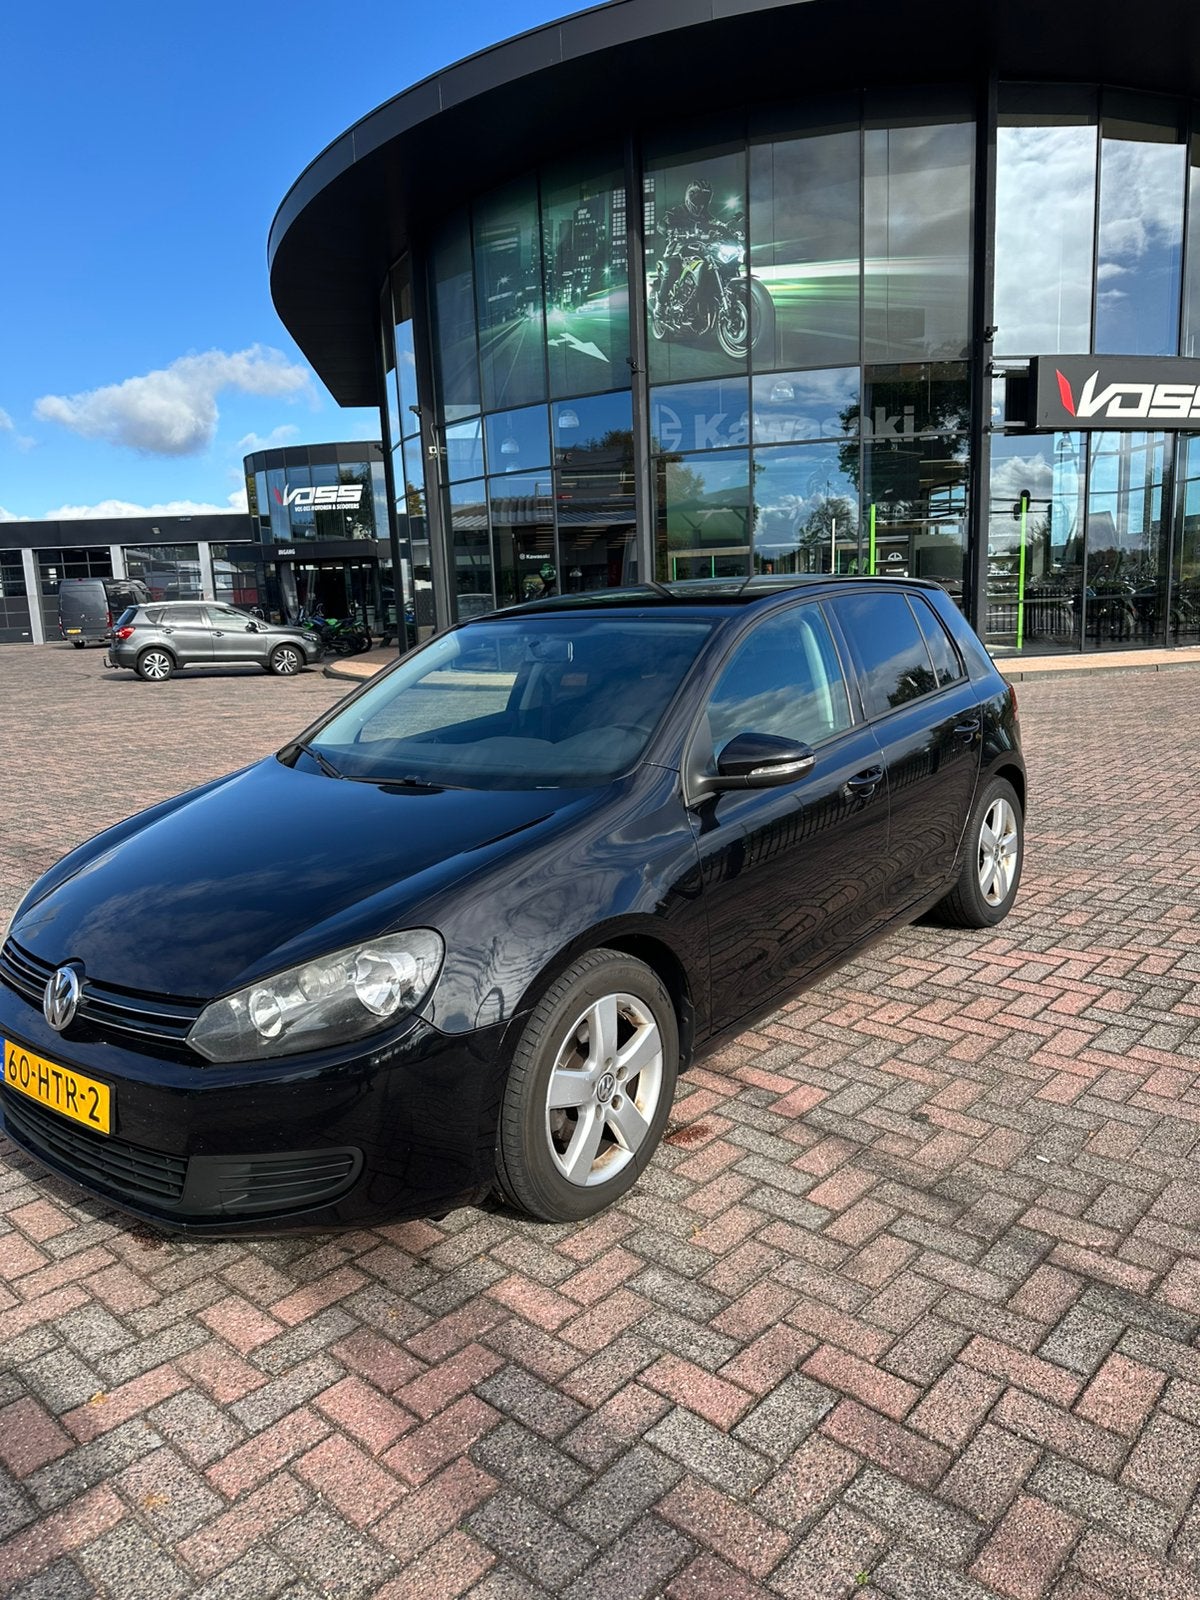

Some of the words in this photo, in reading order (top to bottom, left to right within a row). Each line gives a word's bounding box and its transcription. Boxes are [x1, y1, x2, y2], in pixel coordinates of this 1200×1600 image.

[1056, 369, 1200, 418] VOS
[694, 405, 915, 450] Kawasaki
[273, 483, 363, 506] VOSS
[8, 1049, 101, 1123] 60-HTR-2
